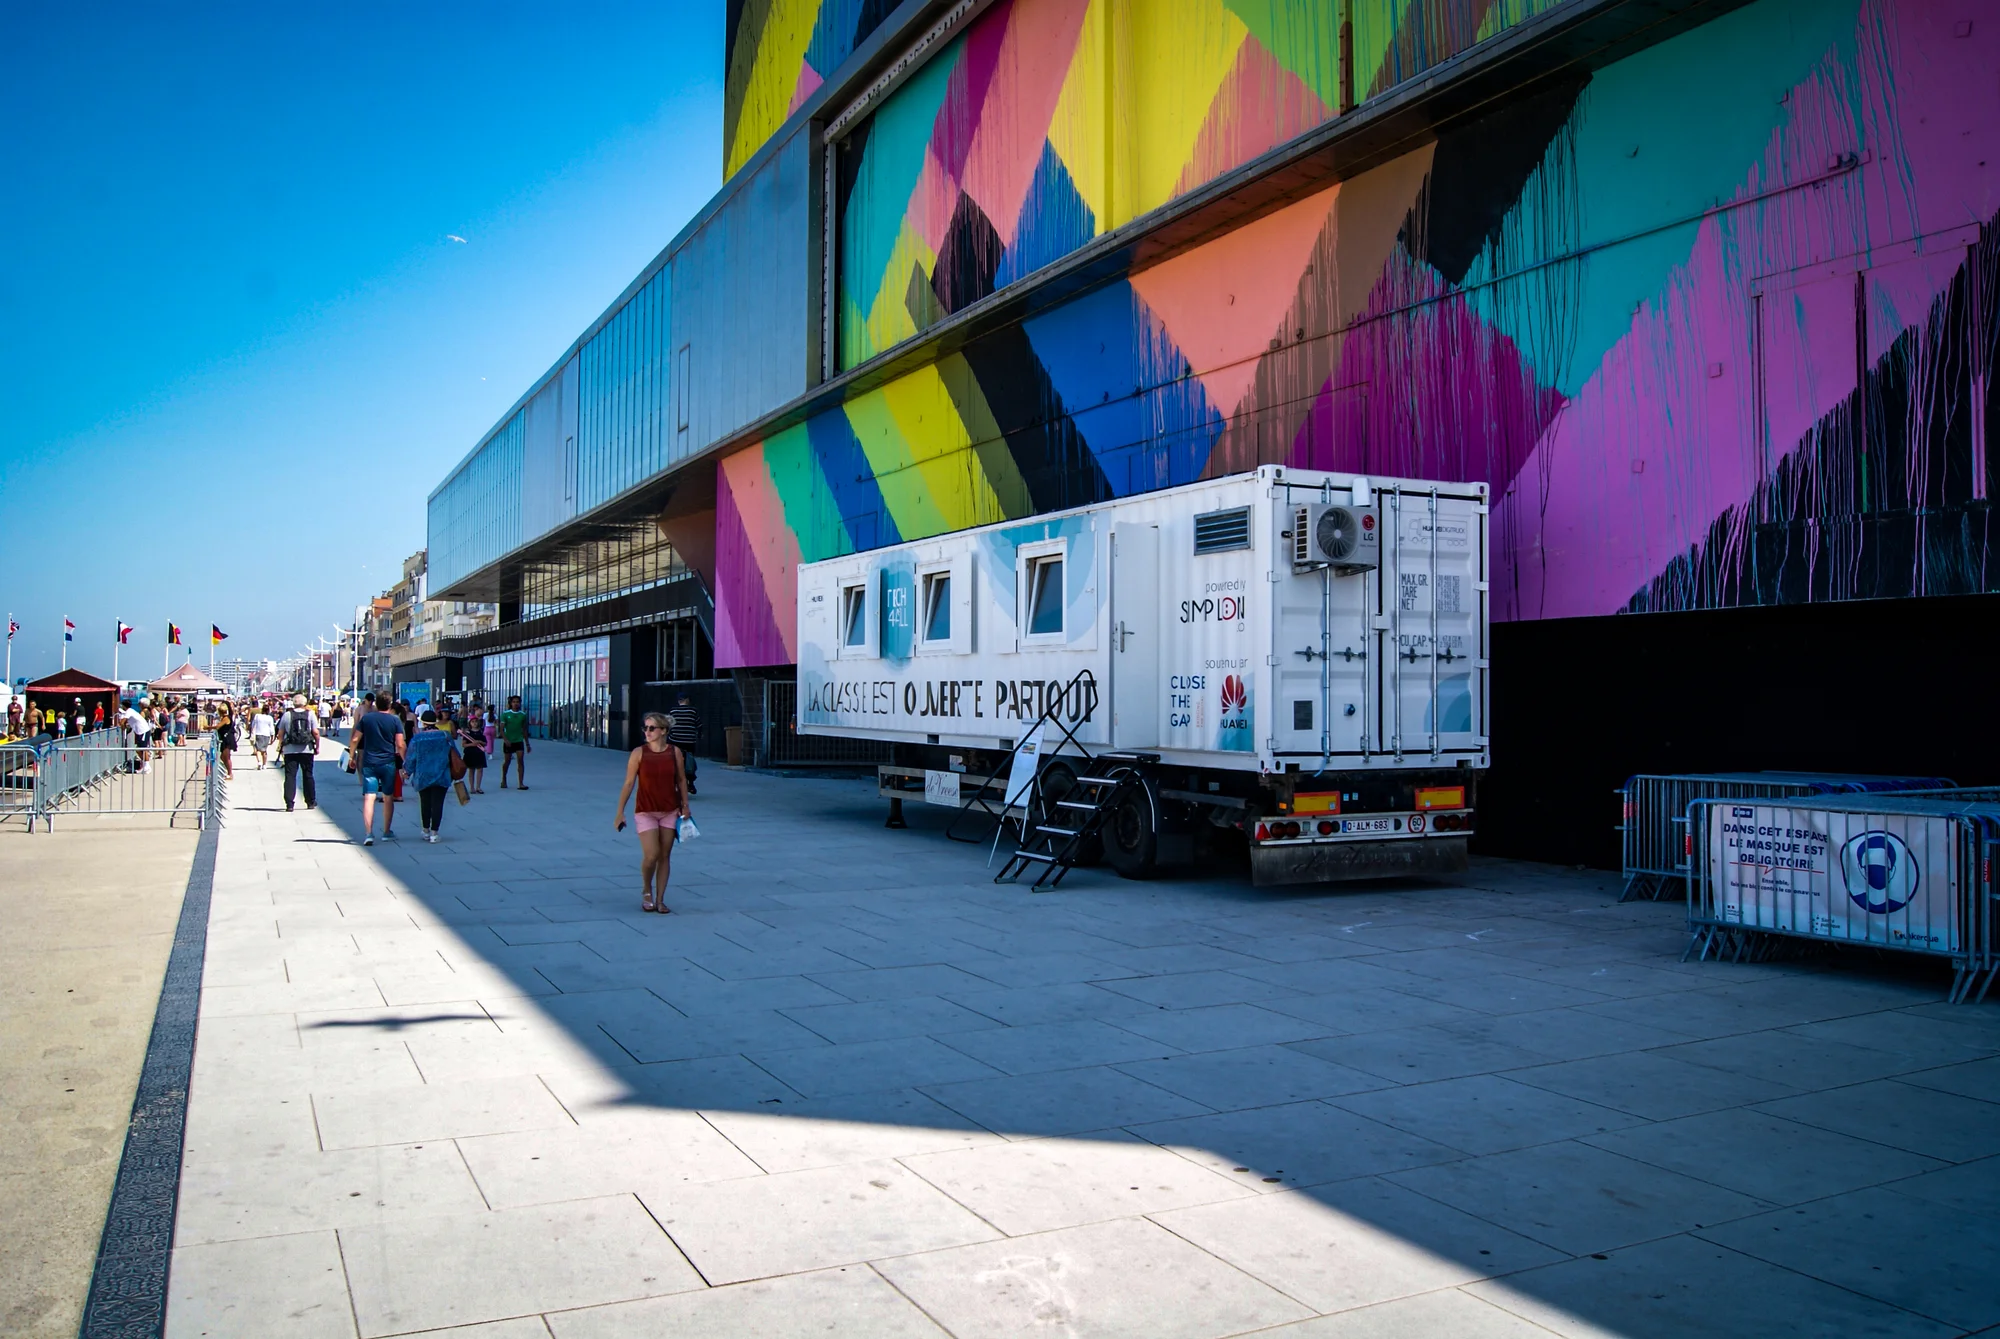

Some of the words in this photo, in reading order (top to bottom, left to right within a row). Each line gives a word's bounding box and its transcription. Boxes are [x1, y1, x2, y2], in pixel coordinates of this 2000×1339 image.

[1363, 532, 1374, 541] LG
[1205, 578, 1239, 595] powred
[1402, 586, 1418, 598] TARE
[1401, 598, 1415, 610] NET
[1171, 675, 1206, 689] CLOSE
[808, 681, 820, 711] LA
[822, 681, 867, 713] CLASSE
[872, 681, 896, 714] EST
[995, 679, 1098, 723] PARTOUT
[1171, 694, 1190, 708] THE
[1412, 817, 1422, 827] 60
[1723, 823, 1755, 835] DANS
[1758, 826, 1783, 837] CET
[1786, 828, 1828, 844] ESPACE
[1729, 838, 1743, 848] LE
[1746, 840, 1800, 854] MASQUE
[1804, 845, 1825, 856] EST
